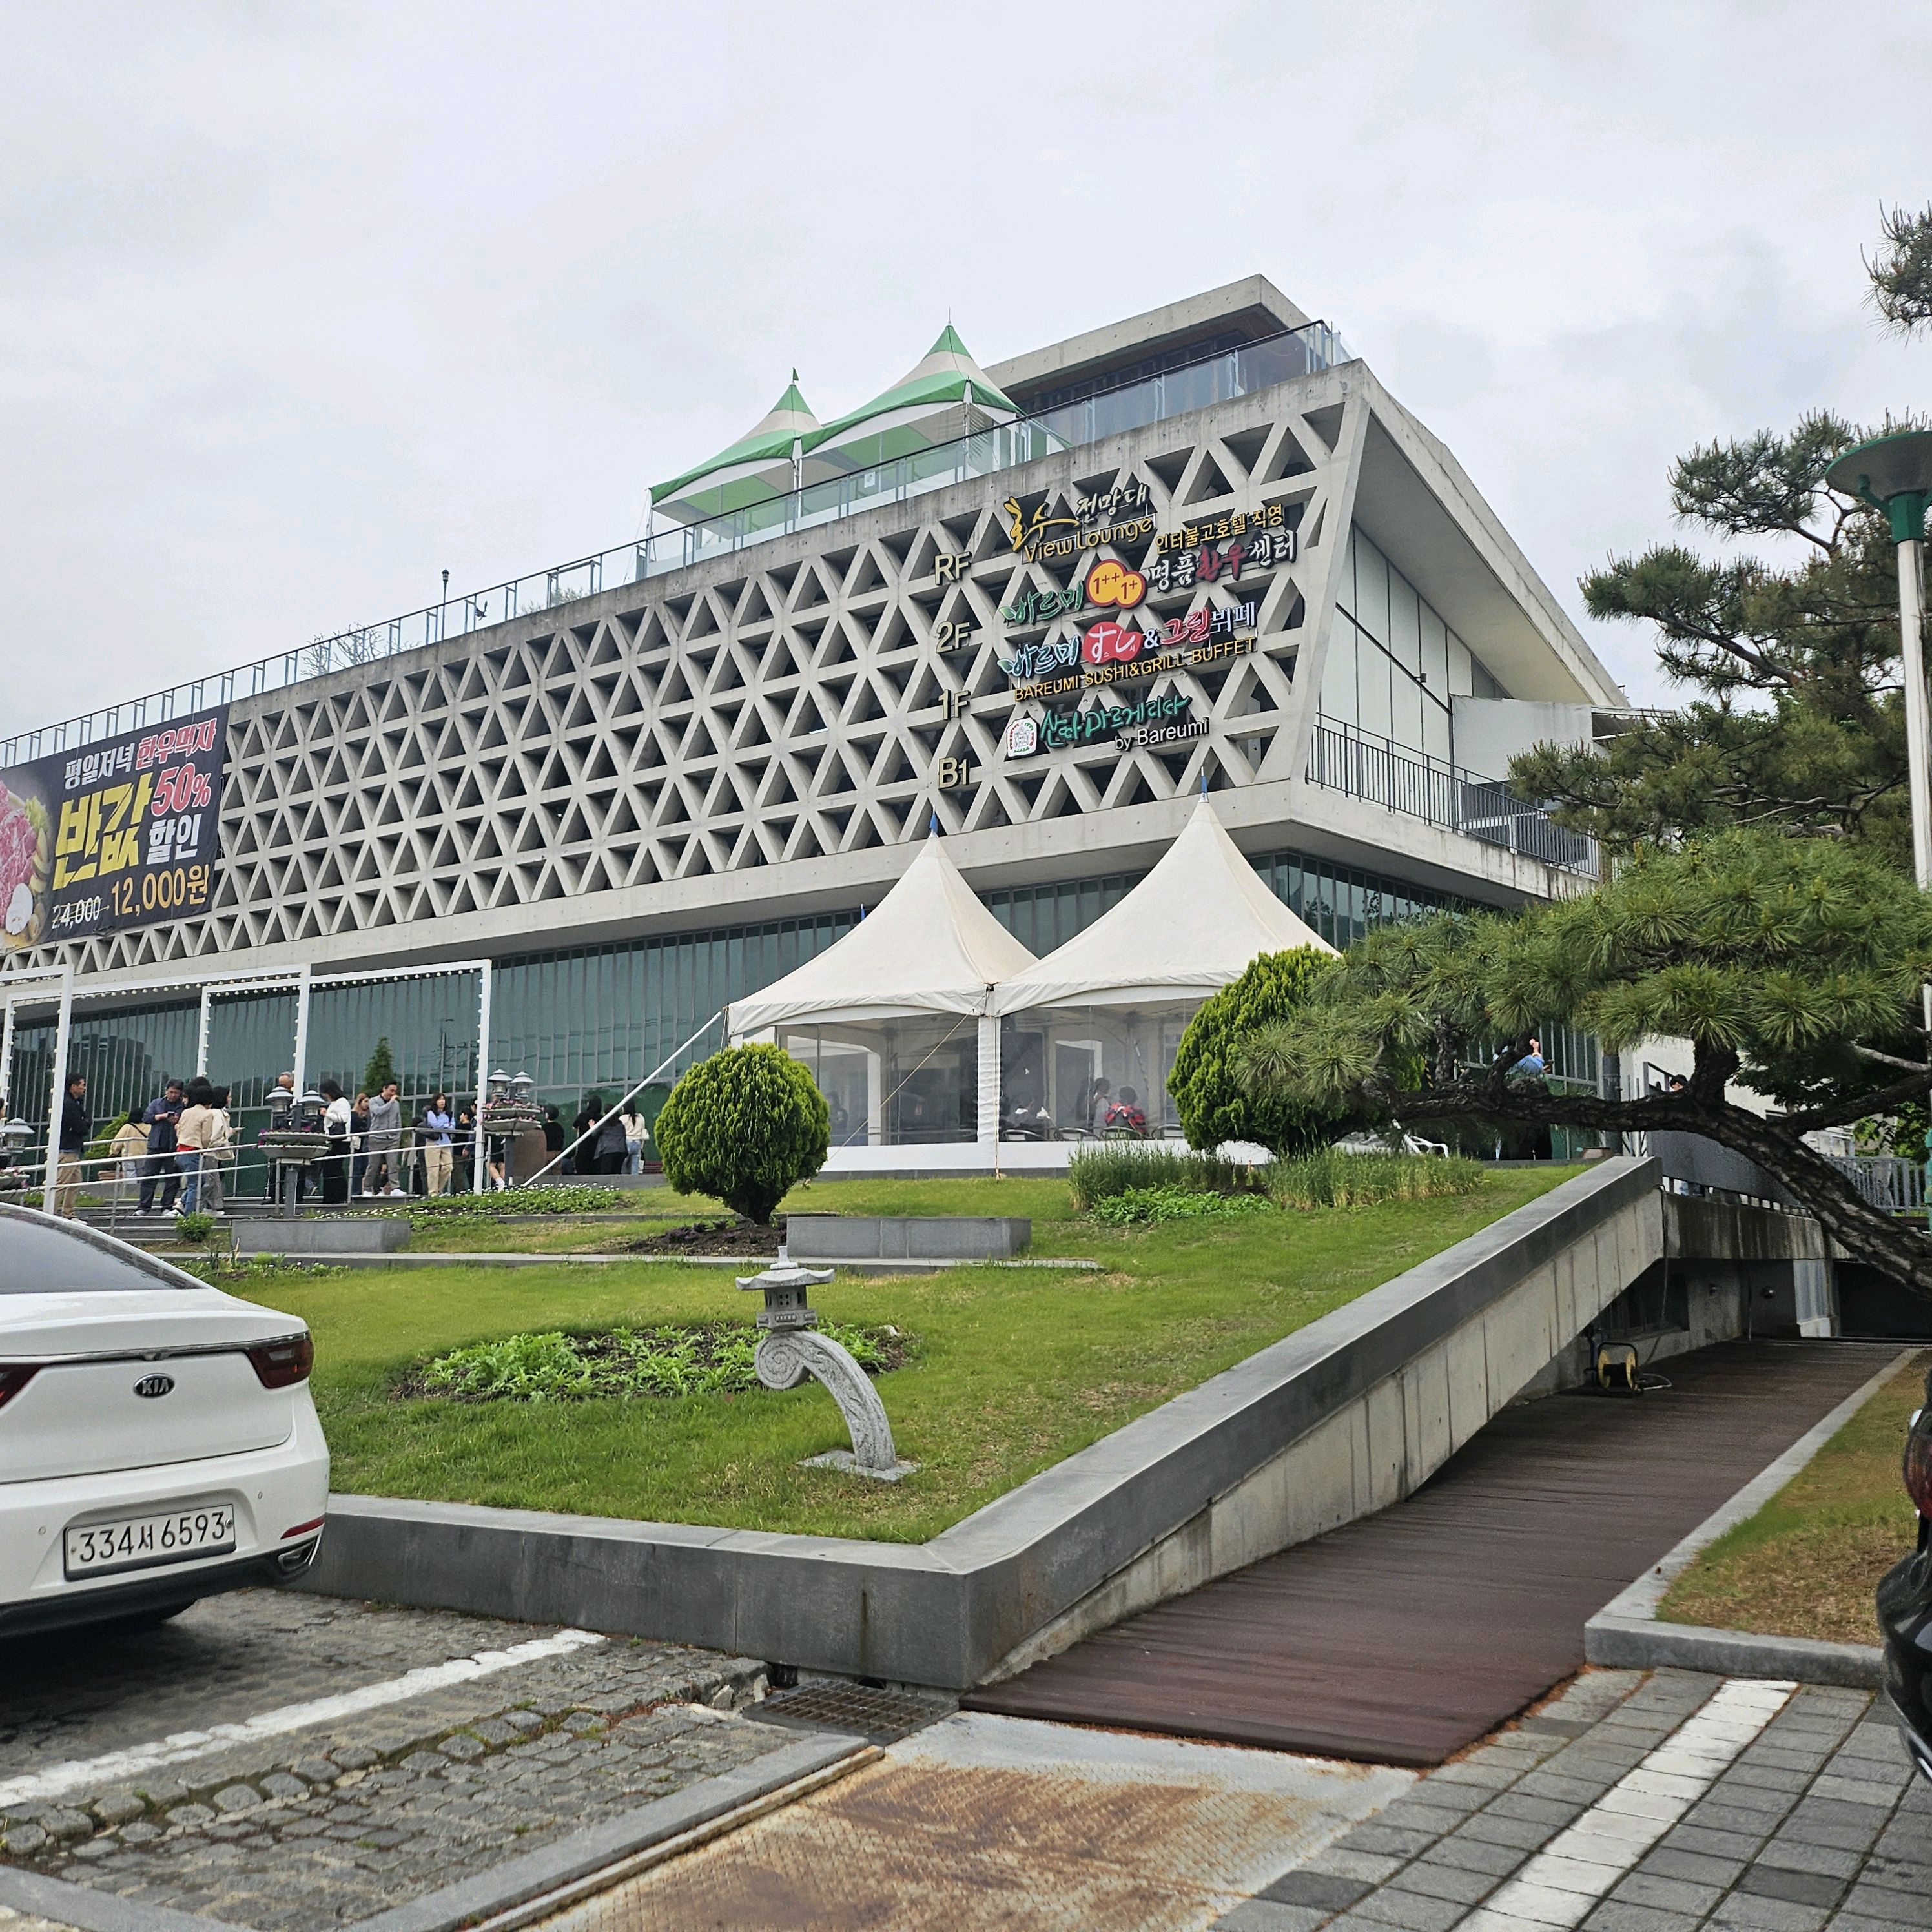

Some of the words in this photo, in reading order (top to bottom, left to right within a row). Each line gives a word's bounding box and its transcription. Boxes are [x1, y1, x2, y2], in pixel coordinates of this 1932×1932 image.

[1076, 484, 1148, 522] 전망대
[1156, 514, 1246, 555] 인터불고호텔
[1253, 504, 1282, 528] 직영
[935, 551, 971, 585] RF
[999, 580, 1084, 624] 바르미
[936, 621, 970, 653] 2F
[998, 635, 1079, 677] 바르미
[1144, 628, 1159, 650] &
[1015, 677, 1079, 701] BAREUMI
[1085, 653, 1186, 686] SUSHI&GRILL
[1192, 637, 1255, 663] BUFFET
[938, 689, 970, 721] 1F
[1115, 735, 1132, 751] by
[1137, 717, 1209, 745] Bareumi
[151, 763, 212, 816] 50%
[939, 757, 968, 789] B1
[52, 772, 153, 890] 반값
[147, 814, 202, 865] 할인
[112, 864, 209, 916] 12,000원
[142, 1379, 169, 1394] KIA
[161, 1512, 225, 1548] 6593
